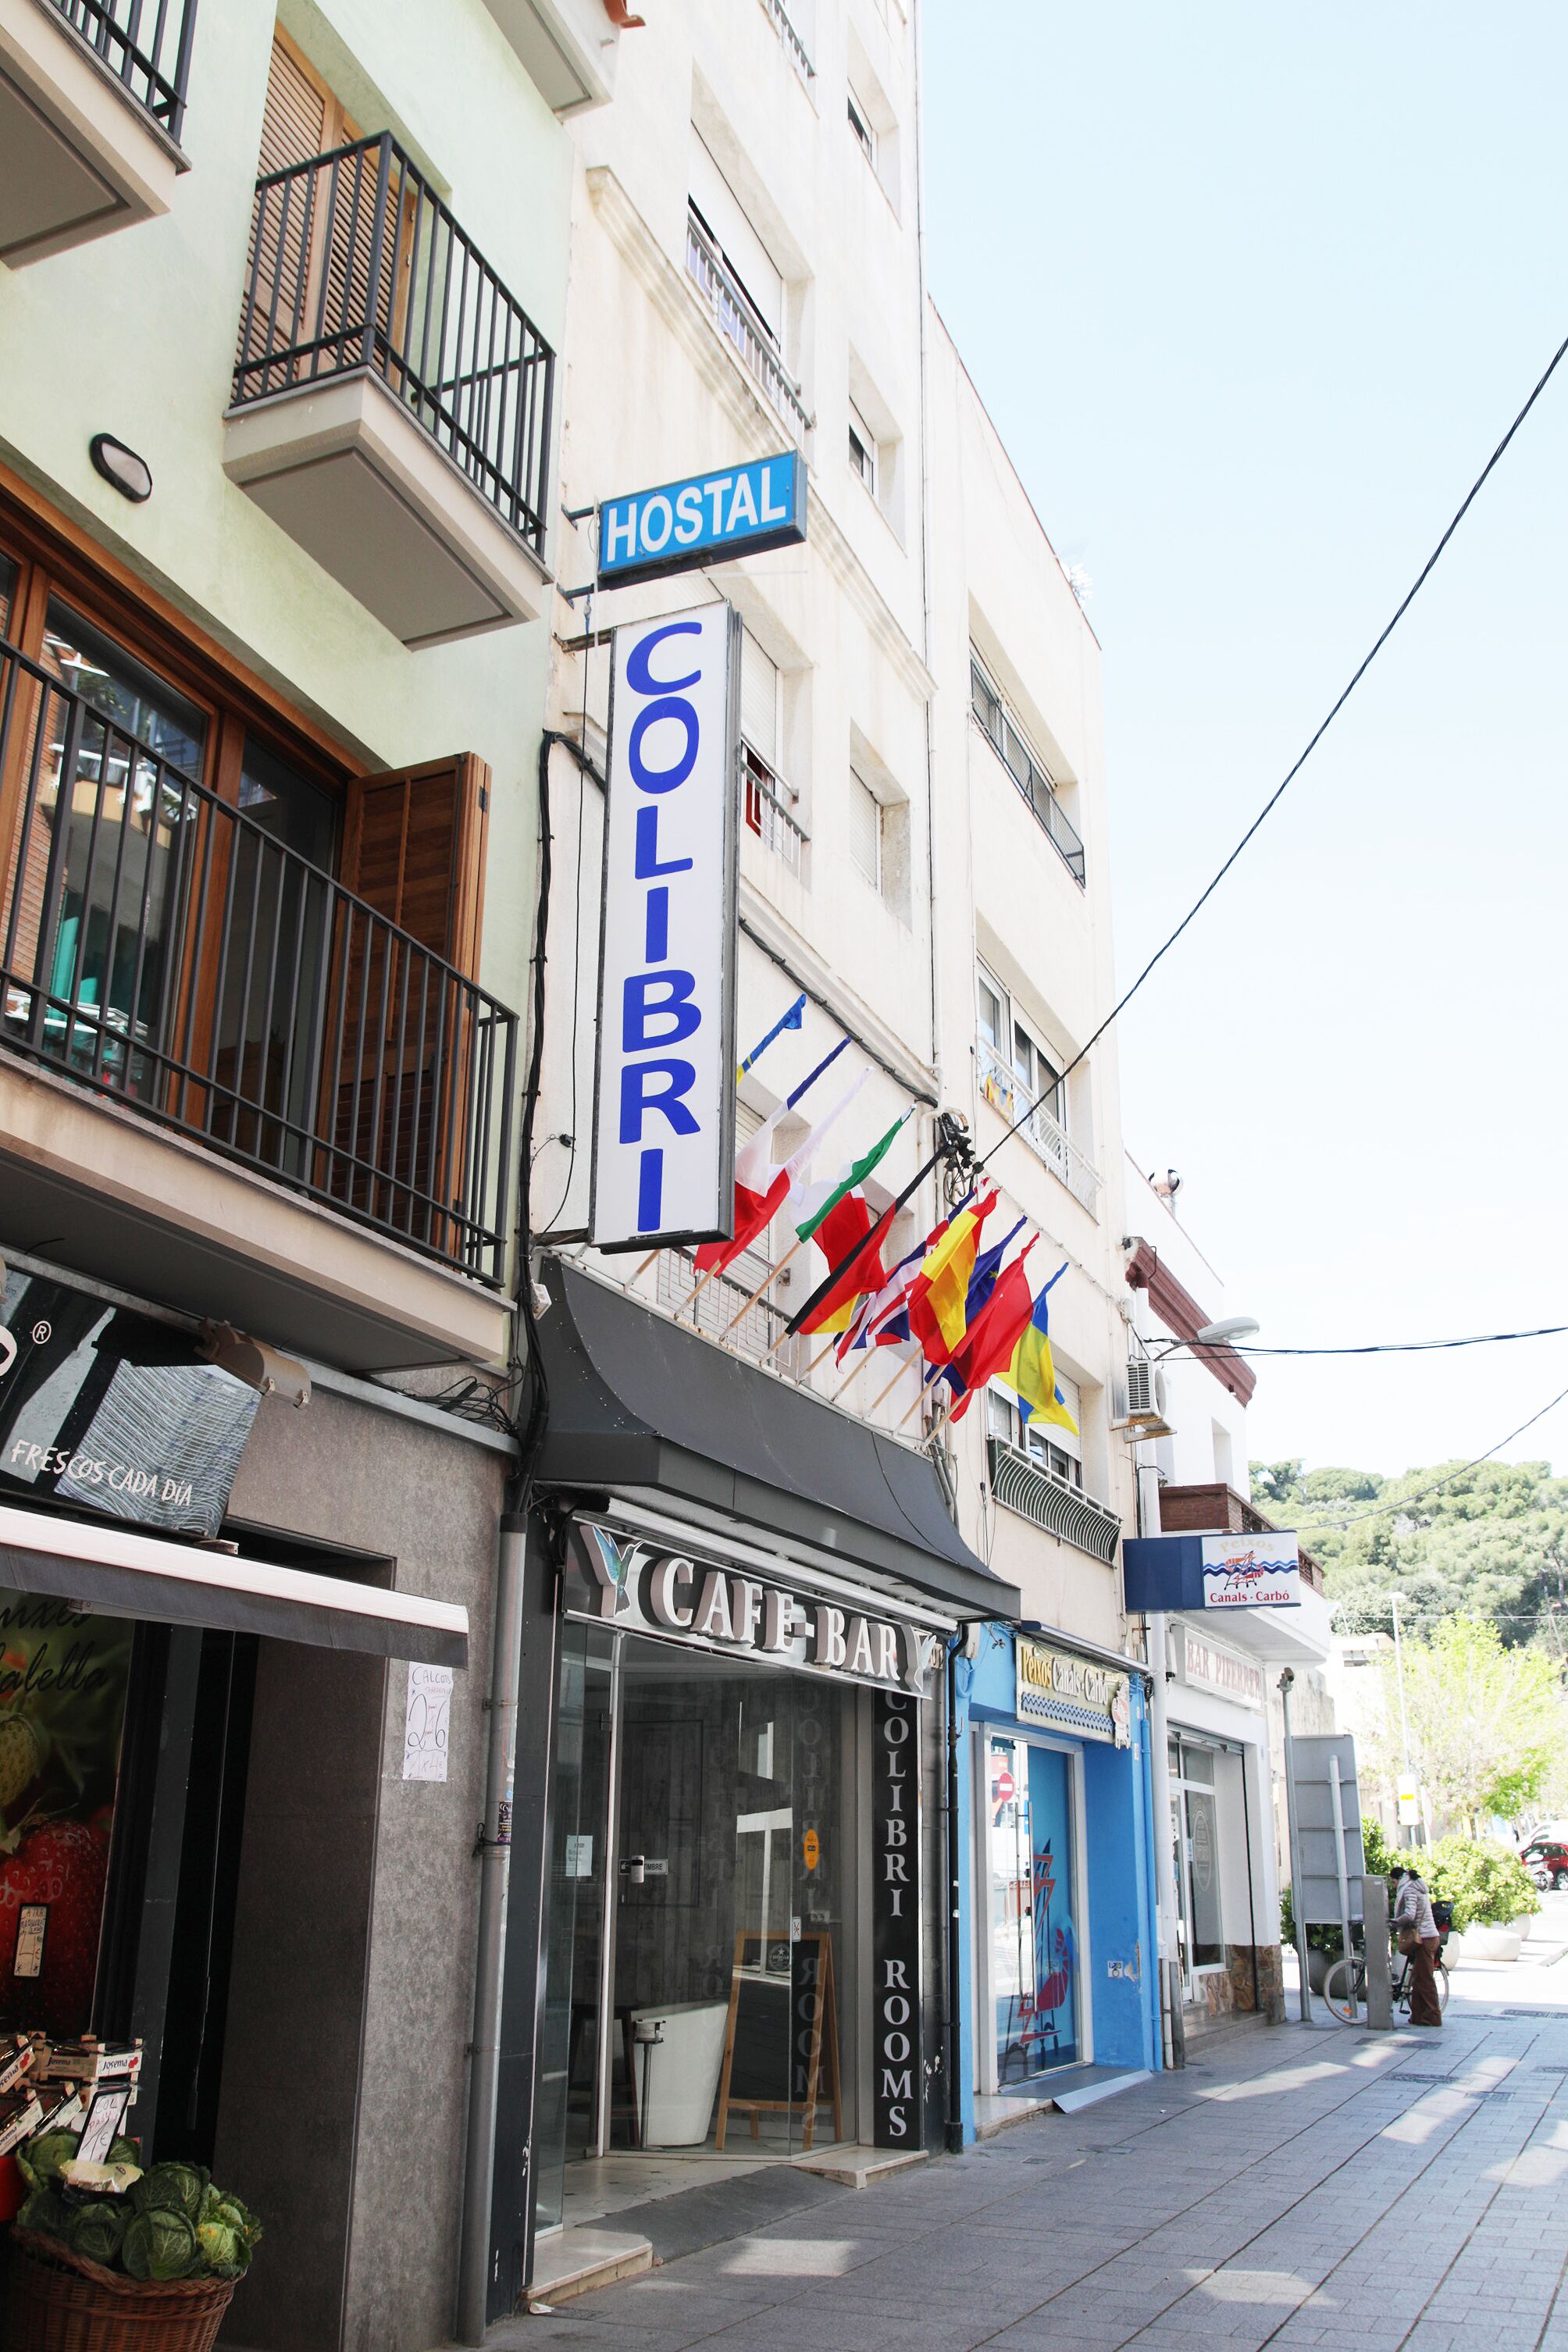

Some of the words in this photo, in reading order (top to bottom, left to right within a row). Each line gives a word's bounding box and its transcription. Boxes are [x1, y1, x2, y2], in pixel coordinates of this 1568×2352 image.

[607, 466, 786, 562] HOSTAL
[618, 622, 703, 1232] COLIBRI
[11, 1439, 107, 1484] FRESCOS
[108, 1465, 157, 1498] CADA
[1210, 1592, 1248, 1603] Canals
[1256, 1590, 1290, 1602] Carbó
[1021, 1646, 1052, 1689] Peixos
[1187, 1639, 1210, 1680] BAR
[102, 2058, 128, 2071] Josema
[881, 1959, 914, 2136] ROOMS
